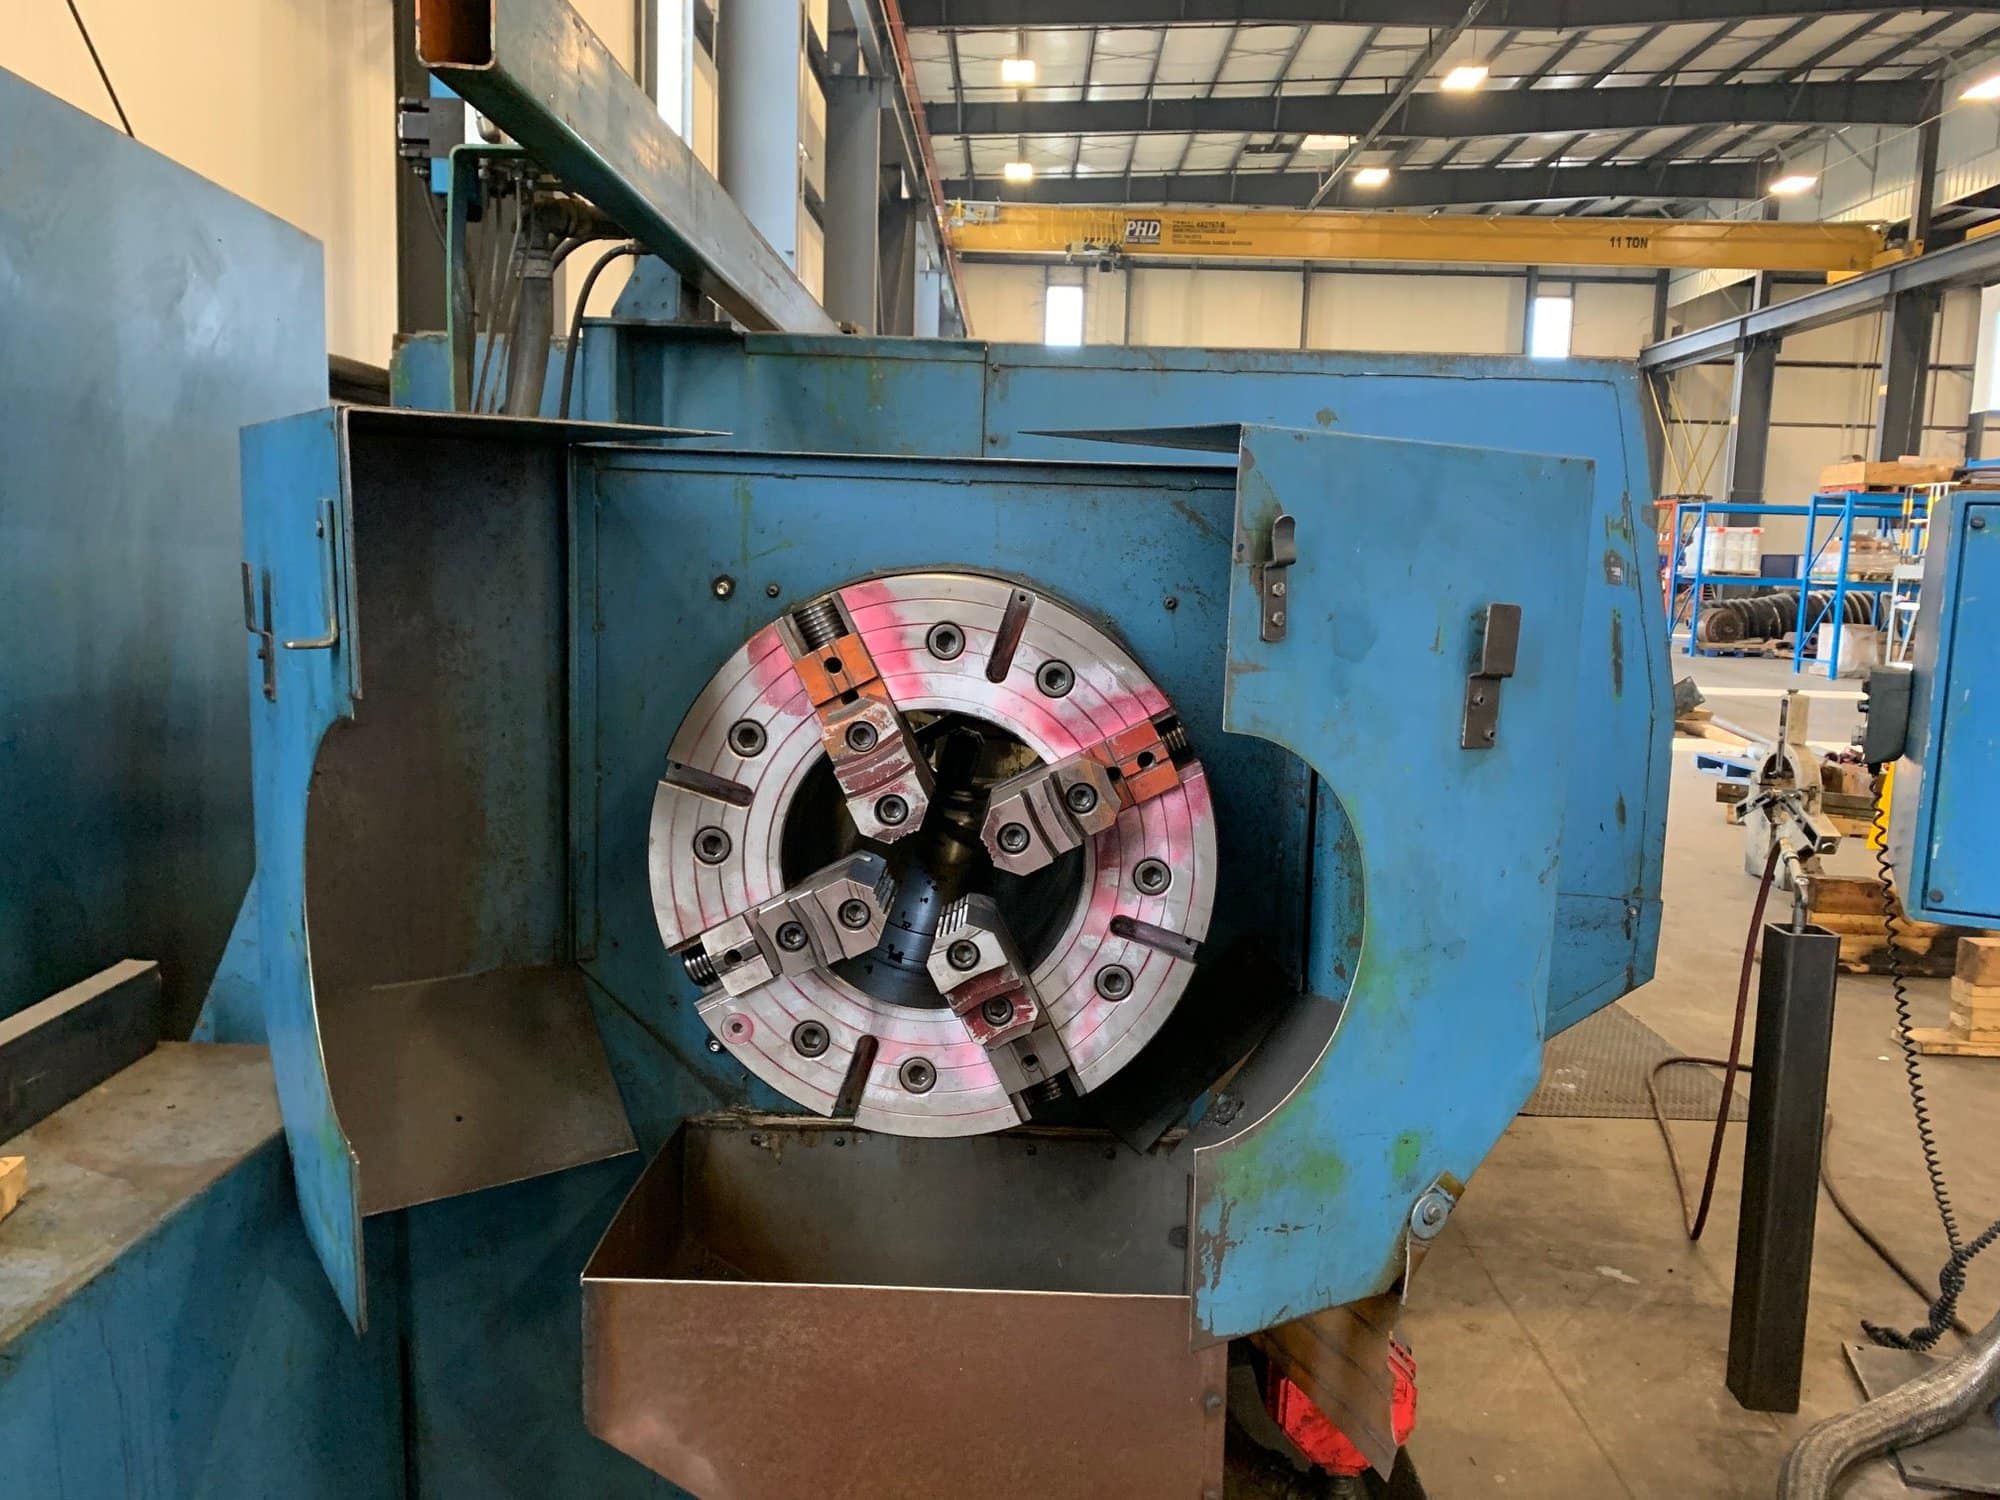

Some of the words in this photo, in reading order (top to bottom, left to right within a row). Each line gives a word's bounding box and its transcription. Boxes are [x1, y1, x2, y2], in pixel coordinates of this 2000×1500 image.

[1125, 221, 1160, 236] PHD
[1610, 236, 1621, 249] 11
[1626, 236, 1649, 249] TON
